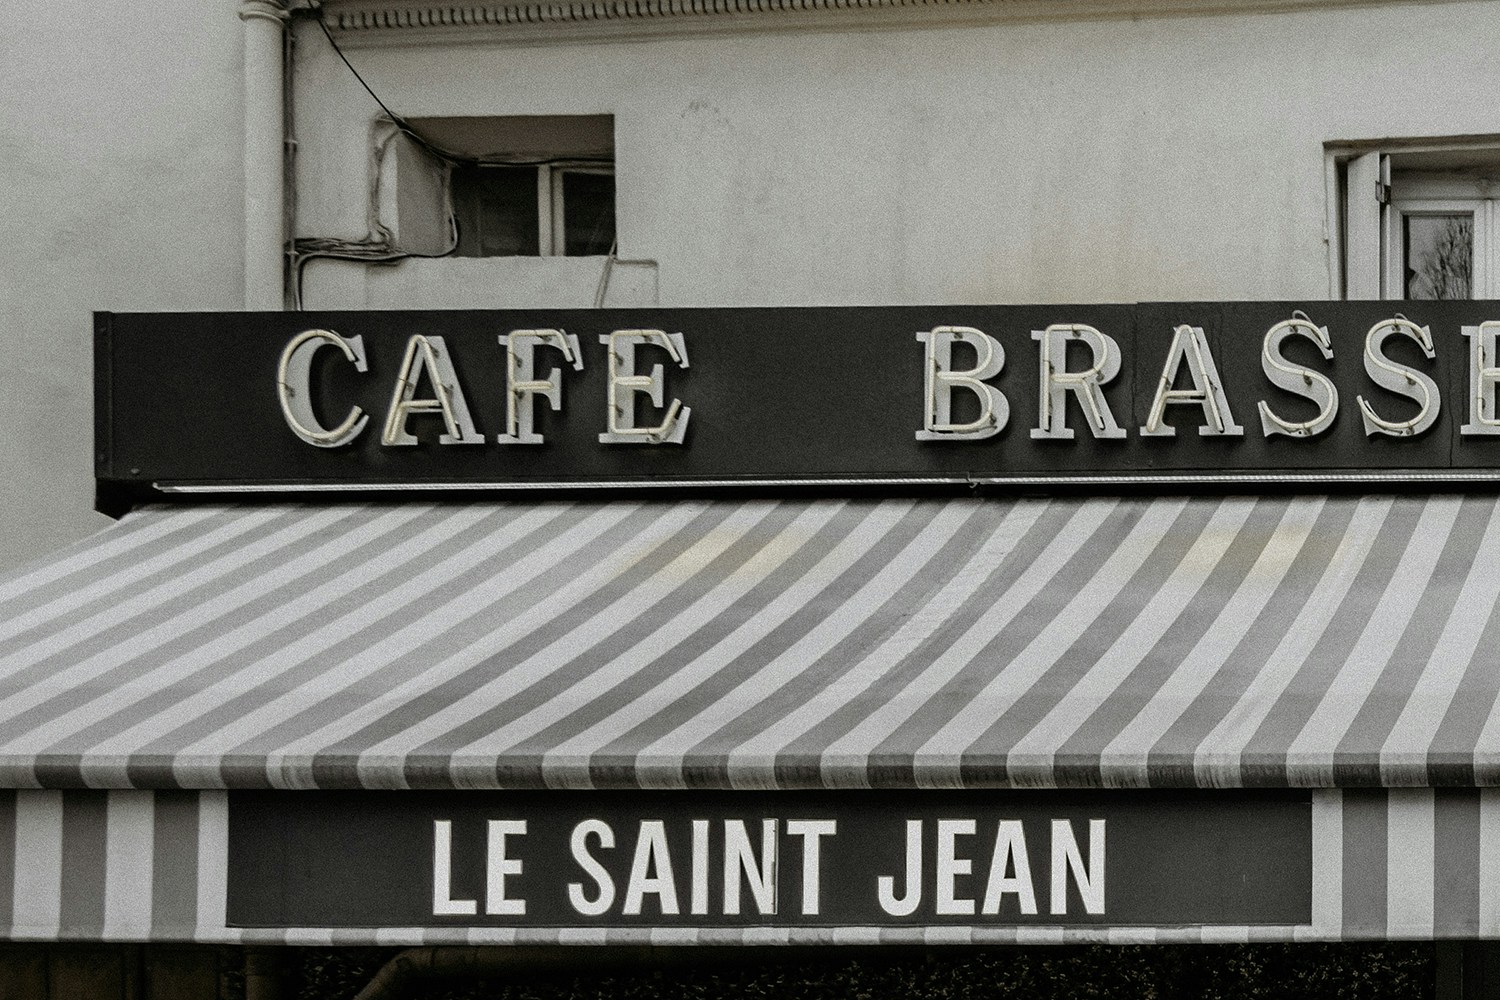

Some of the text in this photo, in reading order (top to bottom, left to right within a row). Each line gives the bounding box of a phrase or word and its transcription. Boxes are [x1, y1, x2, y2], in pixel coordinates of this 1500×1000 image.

[277, 328, 691, 447] CAFE
[433, 818, 1107, 916] LE SAINT JEAN
